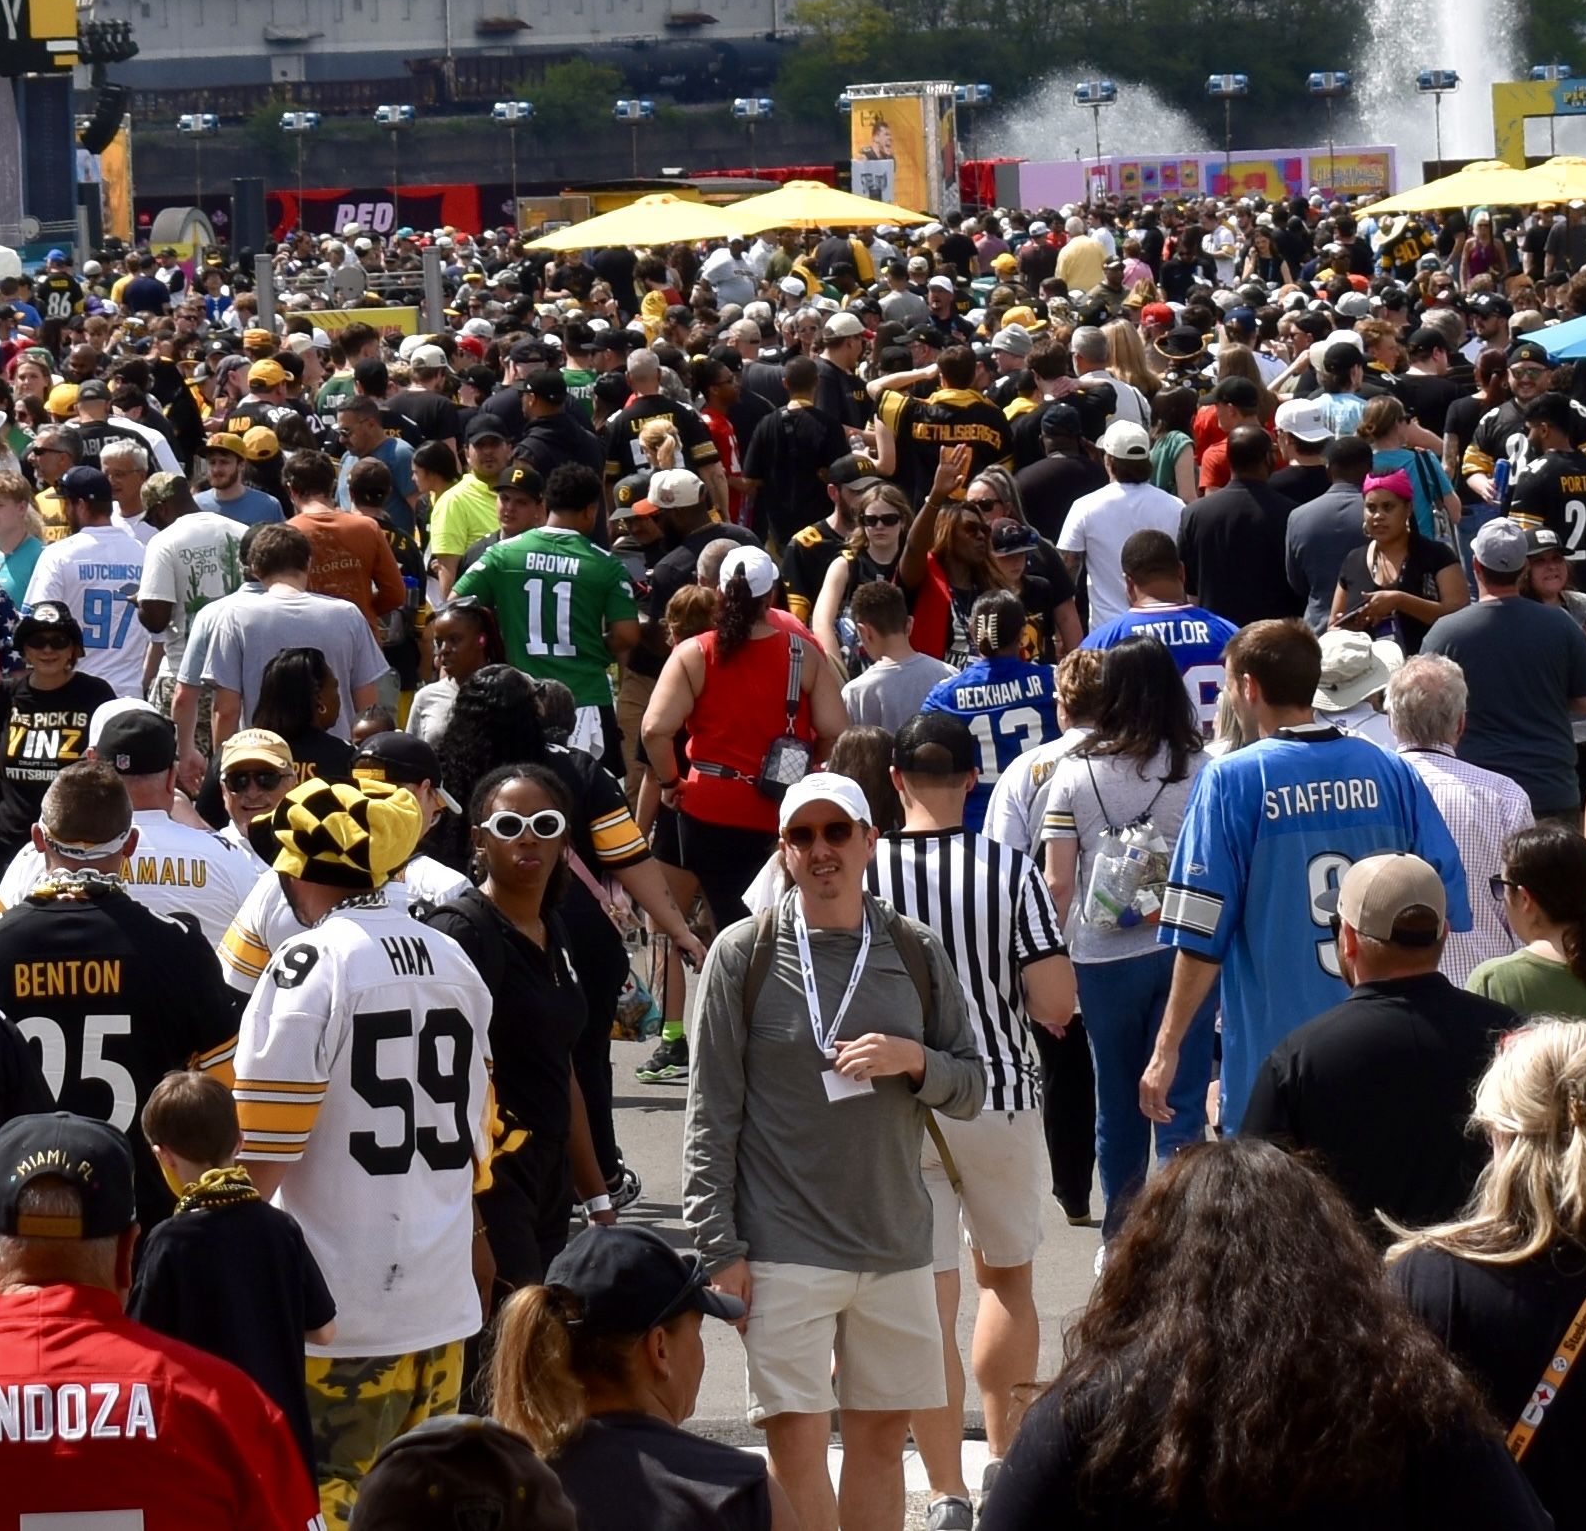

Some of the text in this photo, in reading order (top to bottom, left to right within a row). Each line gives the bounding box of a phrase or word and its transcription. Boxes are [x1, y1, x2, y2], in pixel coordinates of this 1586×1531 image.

[47, 291, 72, 318] 86
[512, 469, 524, 482] P
[179, 546, 217, 566] Desert
[195, 560, 218, 579] Trip
[525, 552, 580, 576] BROWN
[82, 589, 142, 649] 97
[523, 578, 577, 657] 11
[1131, 621, 1209, 647] TAYLOR
[956, 674, 1043, 710] BECKHAM JR
[33, 711, 70, 728] PICK
[72, 710, 88, 726] IS
[7, 726, 80, 759] YINZ
[1264, 779, 1380, 820] STAFFORD
[120, 856, 207, 888] AMALU
[380, 936, 435, 976] HAM
[15, 960, 120, 997] BENTON
[350, 1007, 474, 1176] 59
[17, 1149, 92, 1182] MIAMI, FL
